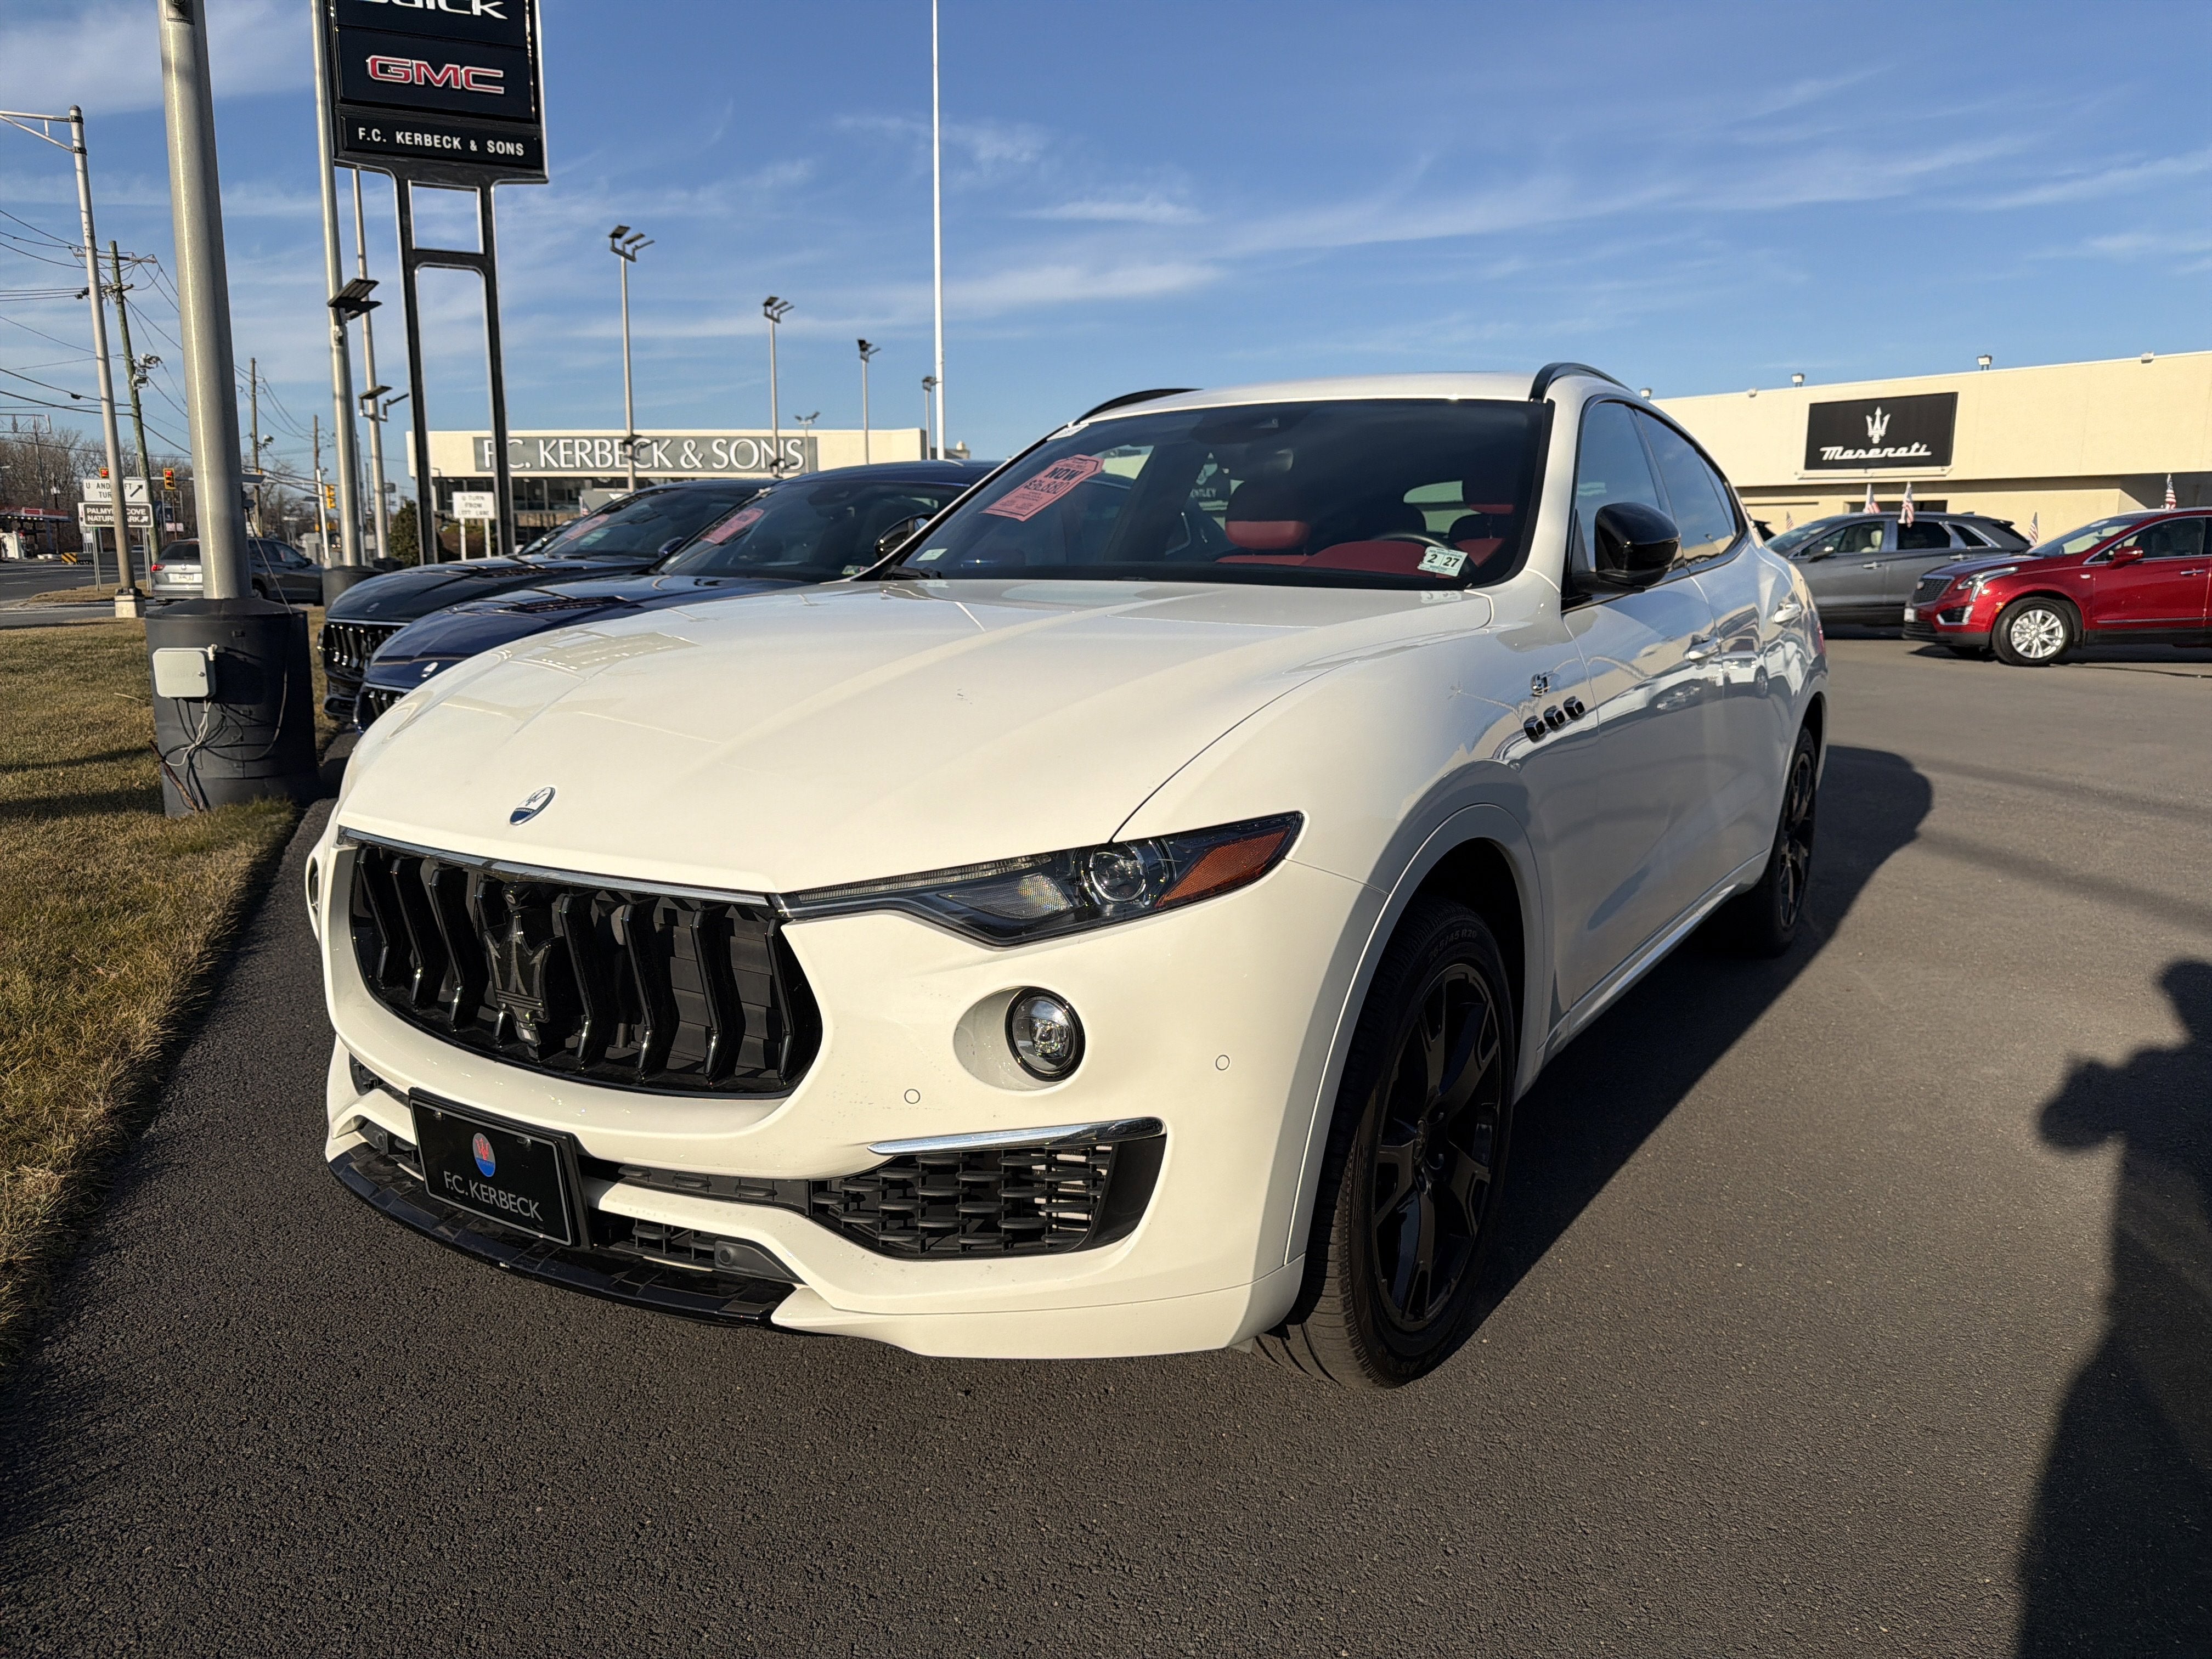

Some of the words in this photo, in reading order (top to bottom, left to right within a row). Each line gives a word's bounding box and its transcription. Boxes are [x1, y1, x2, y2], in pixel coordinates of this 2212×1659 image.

[366, 55, 504, 94] GMC
[358, 128, 387, 143] F.C.
[396, 131, 461, 150] KERBECK
[470, 140, 477, 151] &
[487, 141, 524, 156] SONS
[539, 438, 673, 469] KERBECK
[680, 439, 704, 469] &
[712, 438, 804, 470] SONS
[1820, 442, 1932, 460] Maserati
[1044, 467, 1084, 481] NOW
[1427, 554, 1437, 563] 2
[1443, 557, 1460, 567] 27
[443, 1170, 468, 1196] F.C.
[469, 1180, 543, 1222] KERBECK
